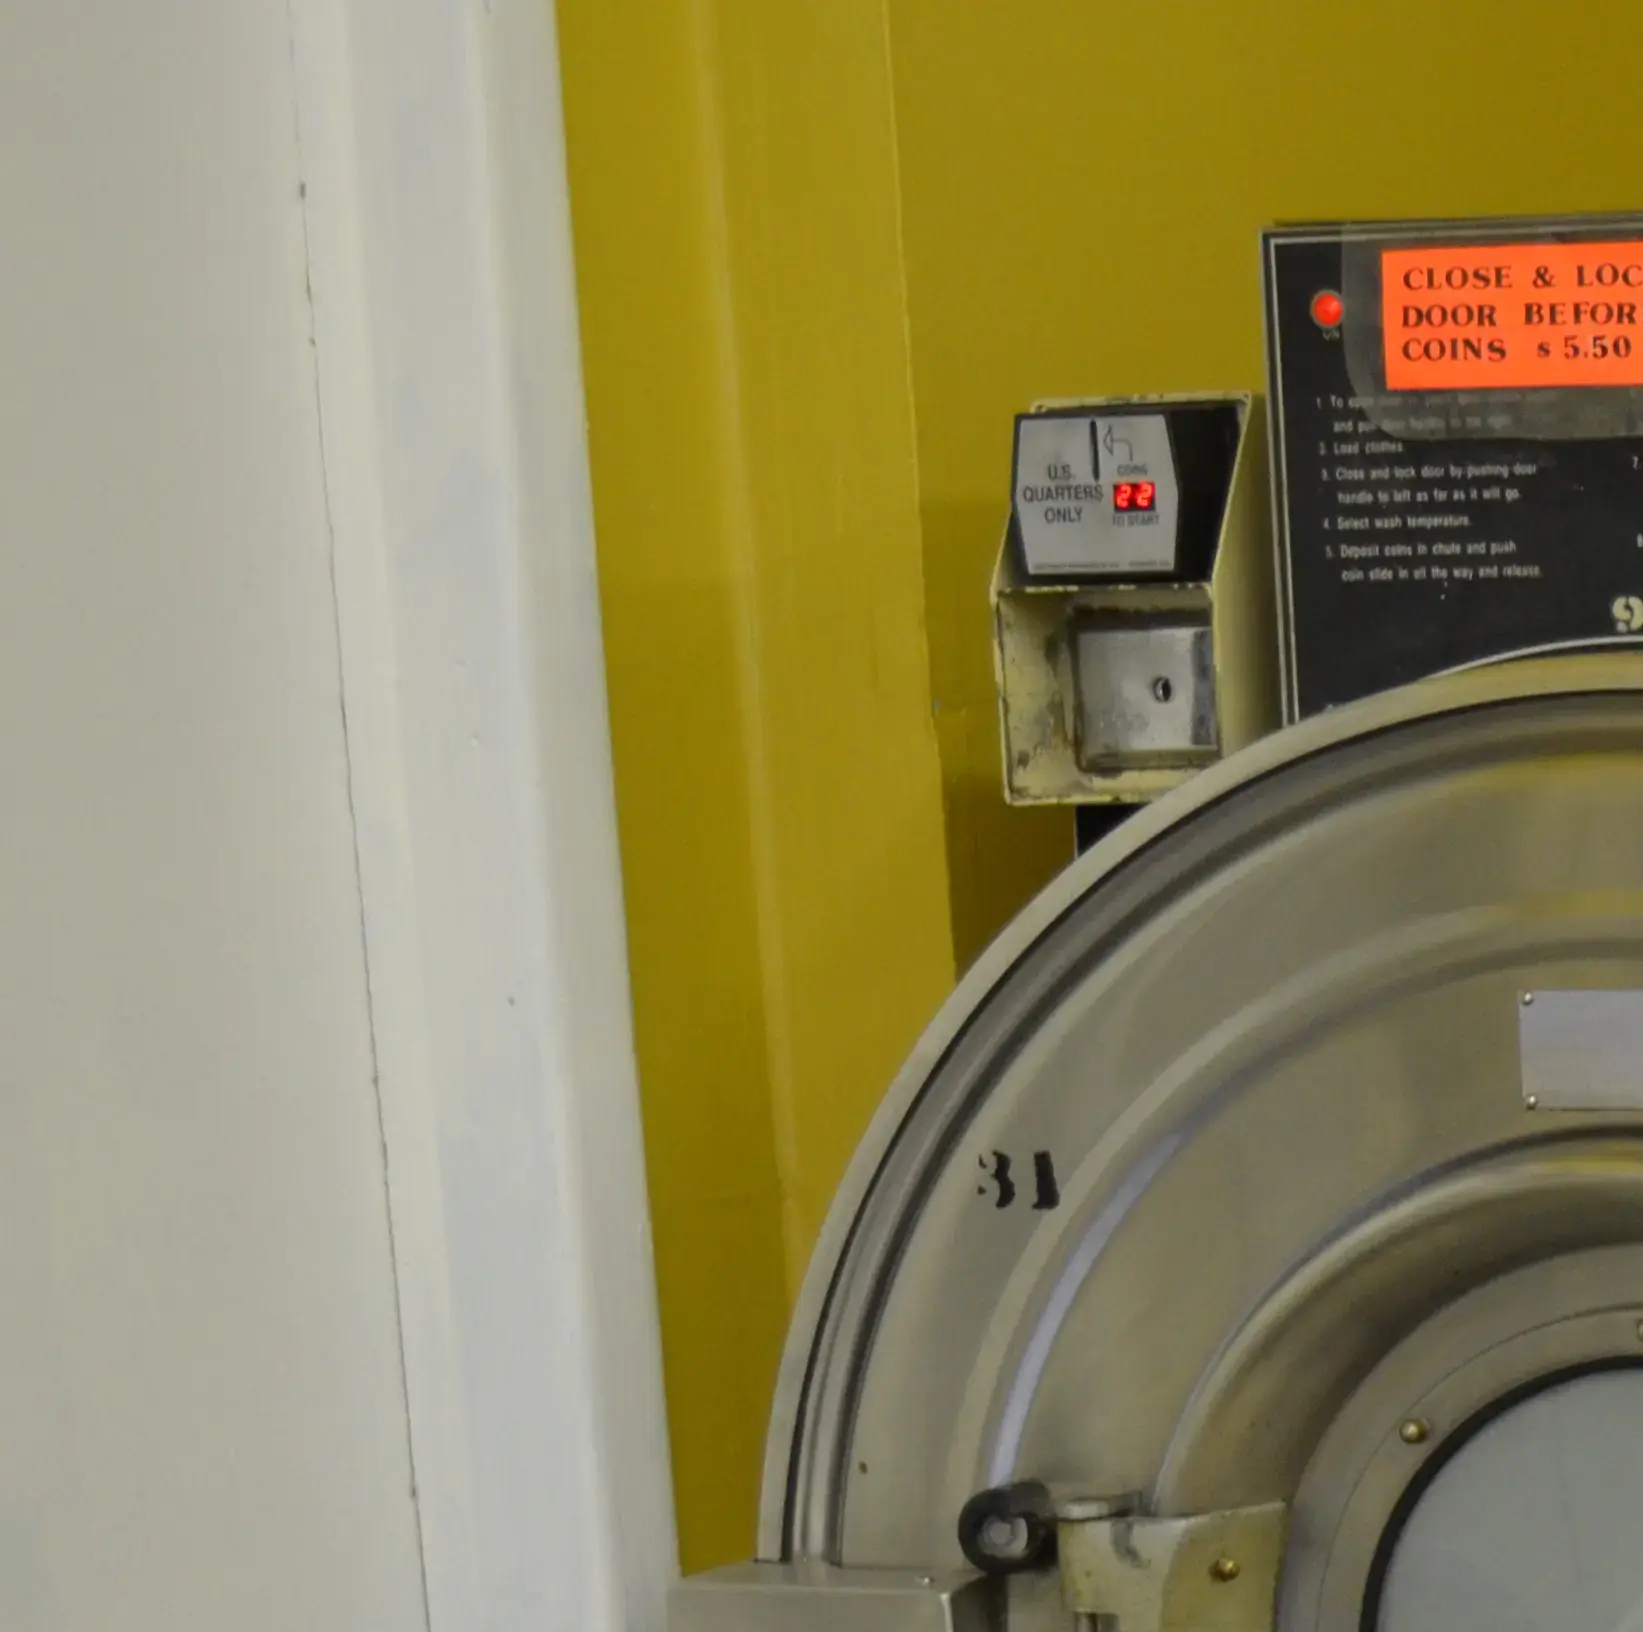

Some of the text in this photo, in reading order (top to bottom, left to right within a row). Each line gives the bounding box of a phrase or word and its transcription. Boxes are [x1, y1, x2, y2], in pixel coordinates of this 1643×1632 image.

[1403, 265, 1512, 290] CLOSE
[1532, 265, 1555, 288] &
[1401, 304, 1497, 329] DOOR
[1401, 338, 1507, 363] COINS
[1563, 335, 1632, 360] 5.50
[1048, 464, 1076, 480] U.S.
[1336, 467, 1365, 480] Close
[1370, 466, 1390, 479] and
[1394, 465, 1415, 478] lock
[1421, 465, 1444, 477] door
[1450, 464, 1462, 478] by
[1467, 463, 1508, 479] pushing
[1513, 463, 1536, 475] door
[1023, 484, 1104, 503] QUARTERS
[1116, 482, 1154, 509] 22
[1337, 490, 1374, 504] handle
[1377, 490, 1389, 503] to
[1393, 489, 1411, 502] left
[1482, 486, 1500, 499] will
[1044, 508, 1083, 524] ONLY
[1337, 516, 1369, 530] Select
[1374, 515, 1402, 529] wash
[1340, 544, 1379, 559] Deposit
[1384, 543, 1412, 556] coins
[1418, 543, 1427, 555] in
[1432, 542, 1461, 555] chute
[1467, 541, 1486, 554] and
[1490, 539, 1516, 556] push
